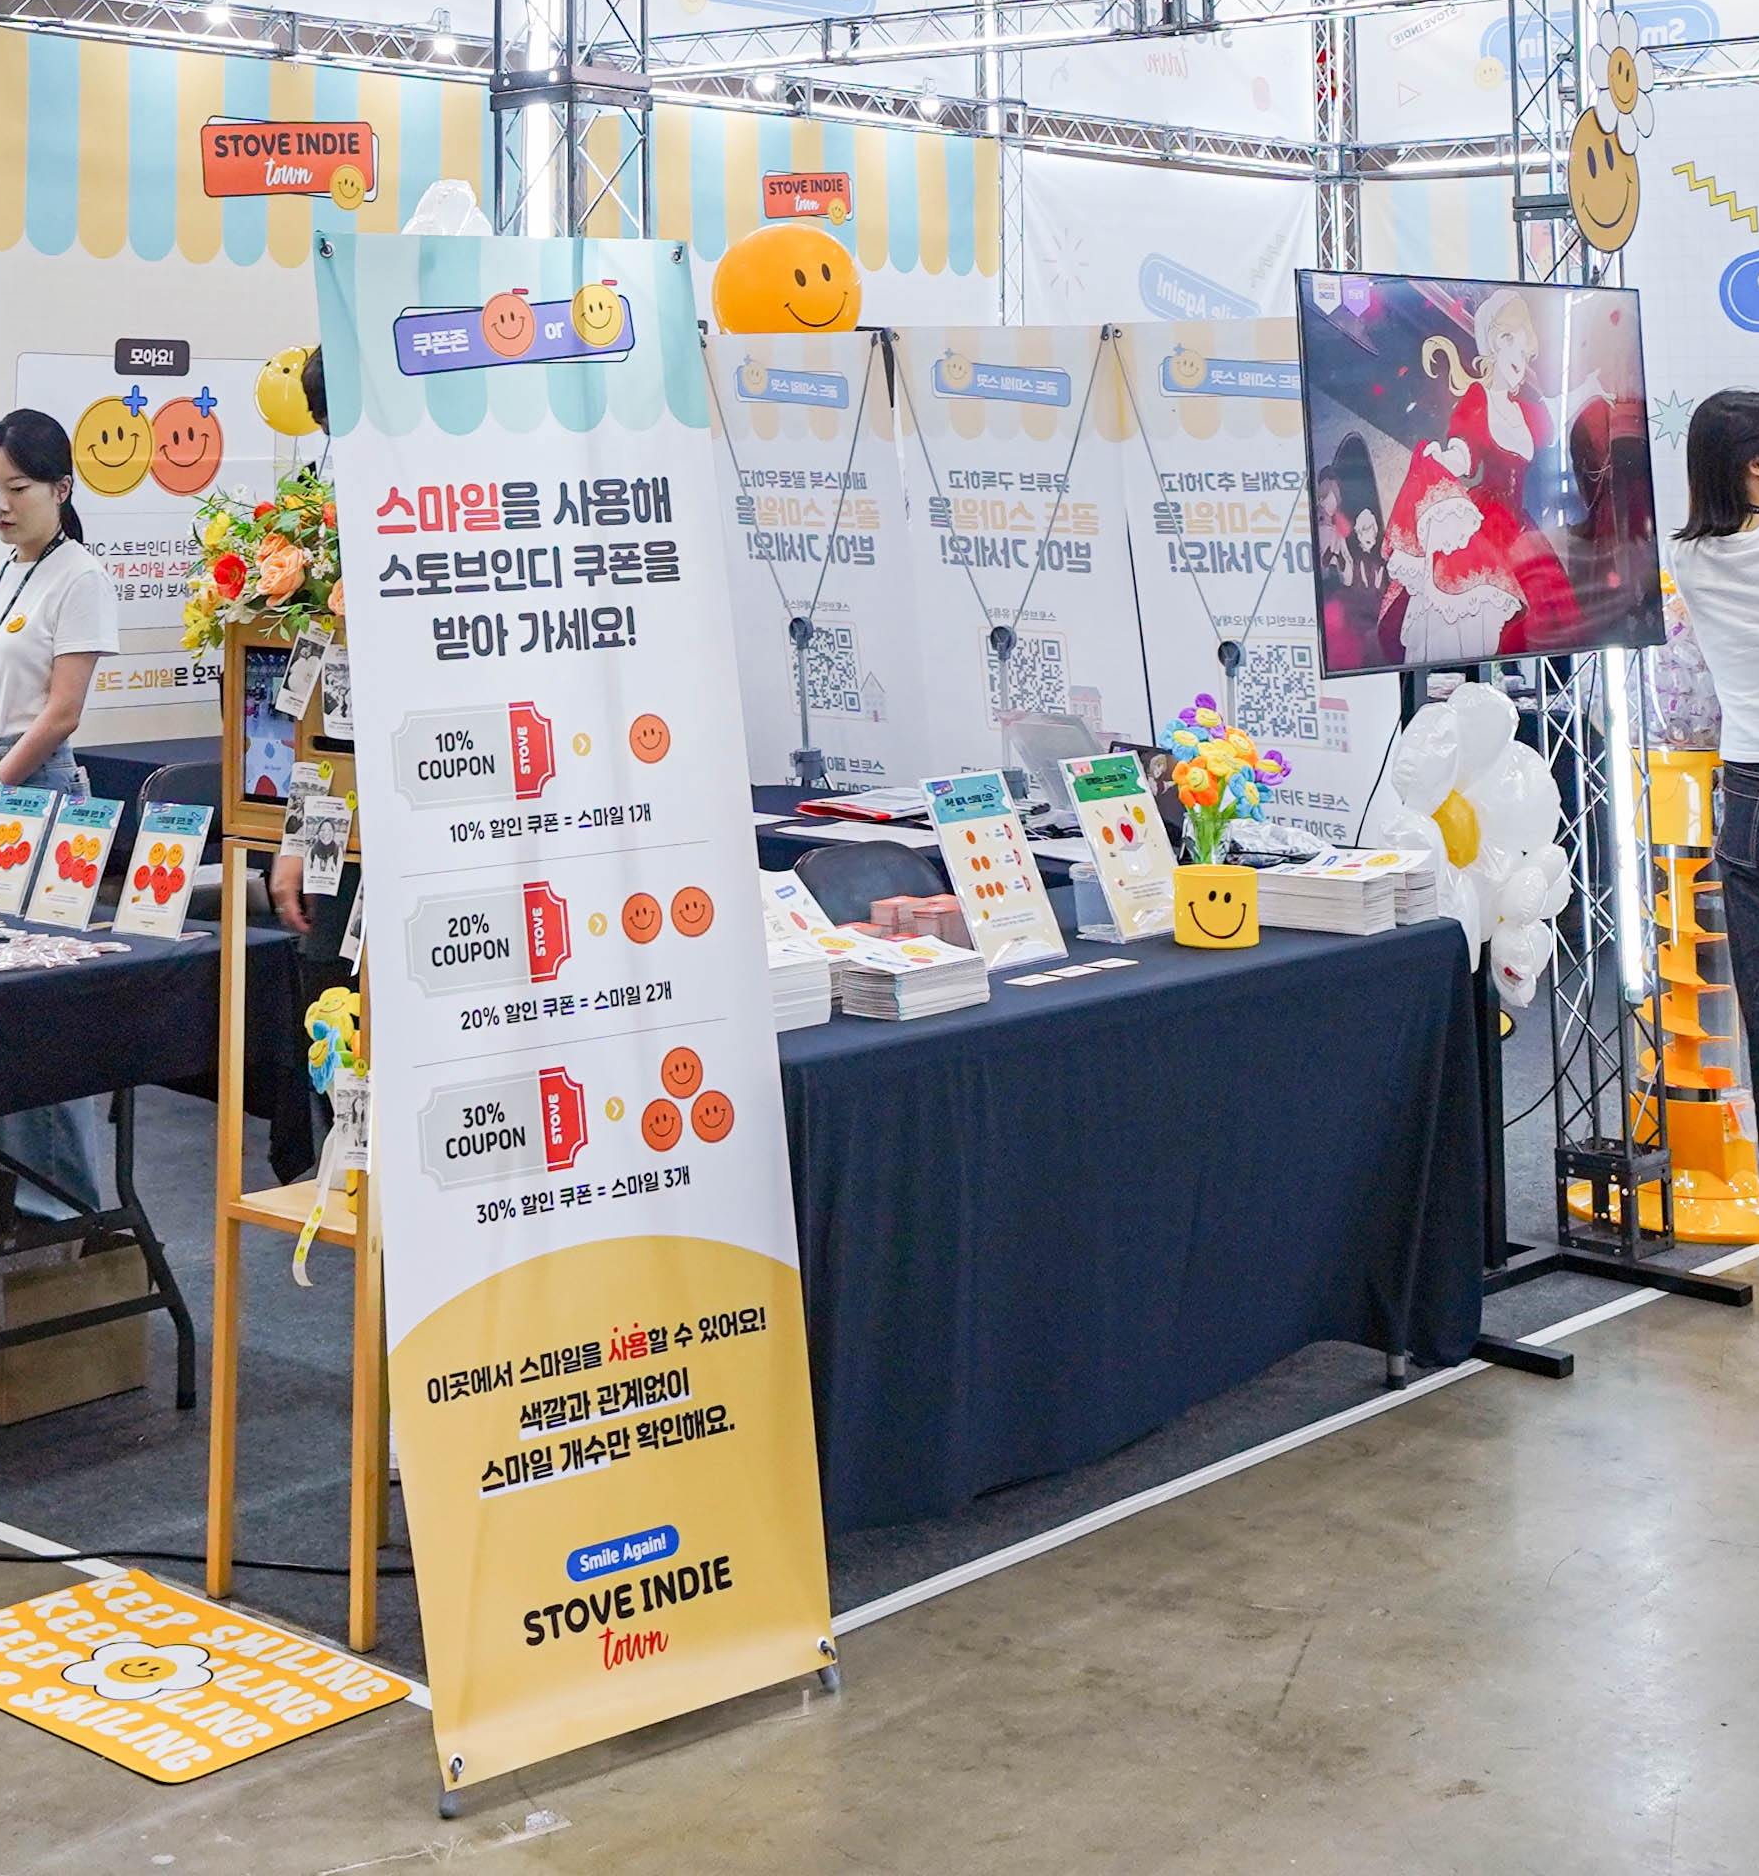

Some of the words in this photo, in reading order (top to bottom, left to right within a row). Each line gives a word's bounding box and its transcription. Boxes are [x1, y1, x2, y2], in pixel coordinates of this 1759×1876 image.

[214, 133, 291, 158] STOVE
[296, 132, 360, 157] INDIE
[264, 158, 313, 187] town
[768, 181, 808, 197] STOVE
[810, 179, 844, 194] INDIE
[794, 194, 820, 212] town
[412, 328, 469, 356] 쿠폰존
[545, 322, 565, 340] or
[129, 347, 174, 368] 모아요!
[376, 481, 542, 534] 스마일을
[553, 477, 672, 527] 사용해
[109, 539, 171, 556] 스토브인디
[128, 562, 165, 579] 스마일
[379, 546, 563, 598] 스토브인디
[573, 540, 681, 587] 쿠폰을
[139, 583, 163, 599] 모아
[433, 613, 507, 661] 받아
[518, 606, 636, 654] 가세요!
[128, 666, 189, 690] 스마일은
[435, 730, 474, 753] 10%
[519, 726, 531, 775] STOVE
[418, 755, 495, 781] COUPON
[450, 820, 485, 843] 10%
[489, 818, 523, 839] 할인
[527, 813, 558, 834] 쿠폰
[578, 807, 624, 829] 스마일
[628, 803, 651, 824] 1개
[448, 914, 489, 938] 20%
[533, 906, 547, 957] STOVE
[431, 937, 510, 968] COUPON
[460, 1007, 500, 1030] 20%
[504, 1001, 537, 1024] 할인
[543, 995, 575, 1016] 쿠폰
[594, 986, 642, 1011] 스마일
[646, 980, 672, 1003] 2개
[462, 1102, 505, 1128] 30%
[547, 1093, 563, 1145] STOVE
[446, 1126, 526, 1160] COUPON
[476, 1199, 517, 1224] 30%
[521, 1191, 555, 1217] 할인
[560, 1185, 592, 1208] 쿠폰
[611, 1172, 660, 1199] 스마일
[663, 1165, 691, 1190] 3개
[427, 1361, 513, 1404] 이곳에서
[520, 1342, 602, 1385] 스마일을
[608, 1328, 669, 1364] 사용할
[674, 1323, 693, 1349] 수
[698, 1307, 766, 1343] 있어요!
[520, 1389, 591, 1430] 색깔과
[597, 1368, 690, 1417] 관계없이
[482, 1447, 553, 1493] 스마일
[561, 1428, 631, 1472] 개수만
[636, 1405, 735, 1451] 확인해요.
[579, 1548, 620, 1574] Smile
[622, 1535, 667, 1562] Again!
[28, 1589, 141, 1649] KEEP
[523, 1583, 635, 1646] STOVE
[639, 1555, 732, 1614] INDIE
[86, 1572, 199, 1630] KEEP
[189, 1625, 389, 1702] SMILING
[598, 1627, 669, 1671] town
[8, 1686, 213, 1772] SMILING
